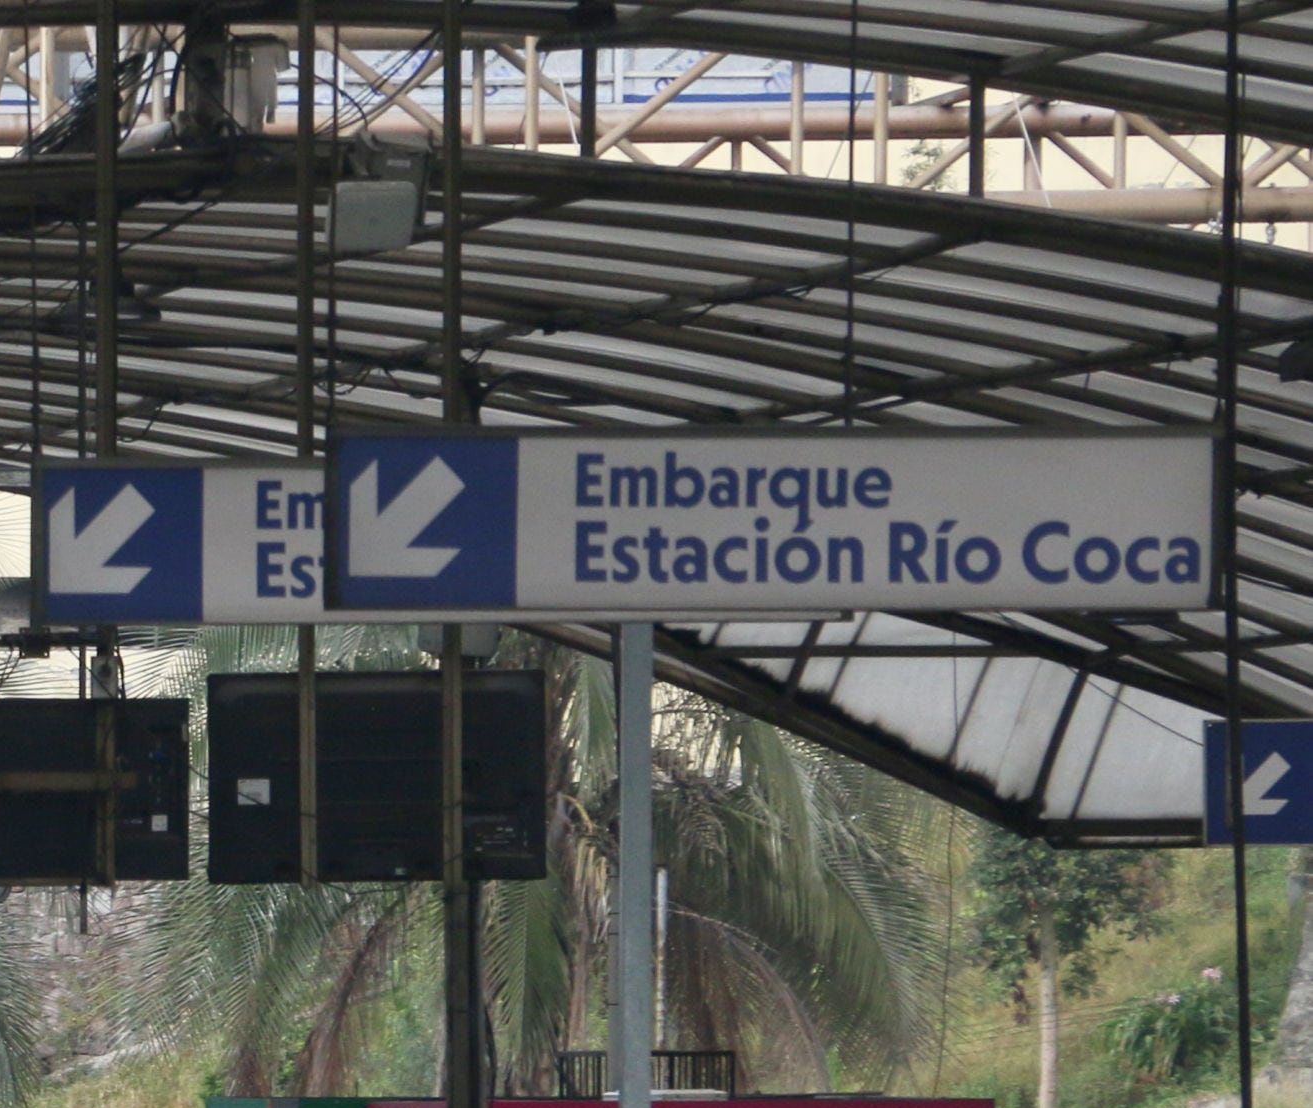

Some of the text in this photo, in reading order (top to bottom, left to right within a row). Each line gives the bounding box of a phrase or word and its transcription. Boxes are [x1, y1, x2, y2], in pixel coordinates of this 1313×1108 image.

[575, 453, 892, 528] Embarque
[575, 517, 1202, 585] Estación Río Coca
